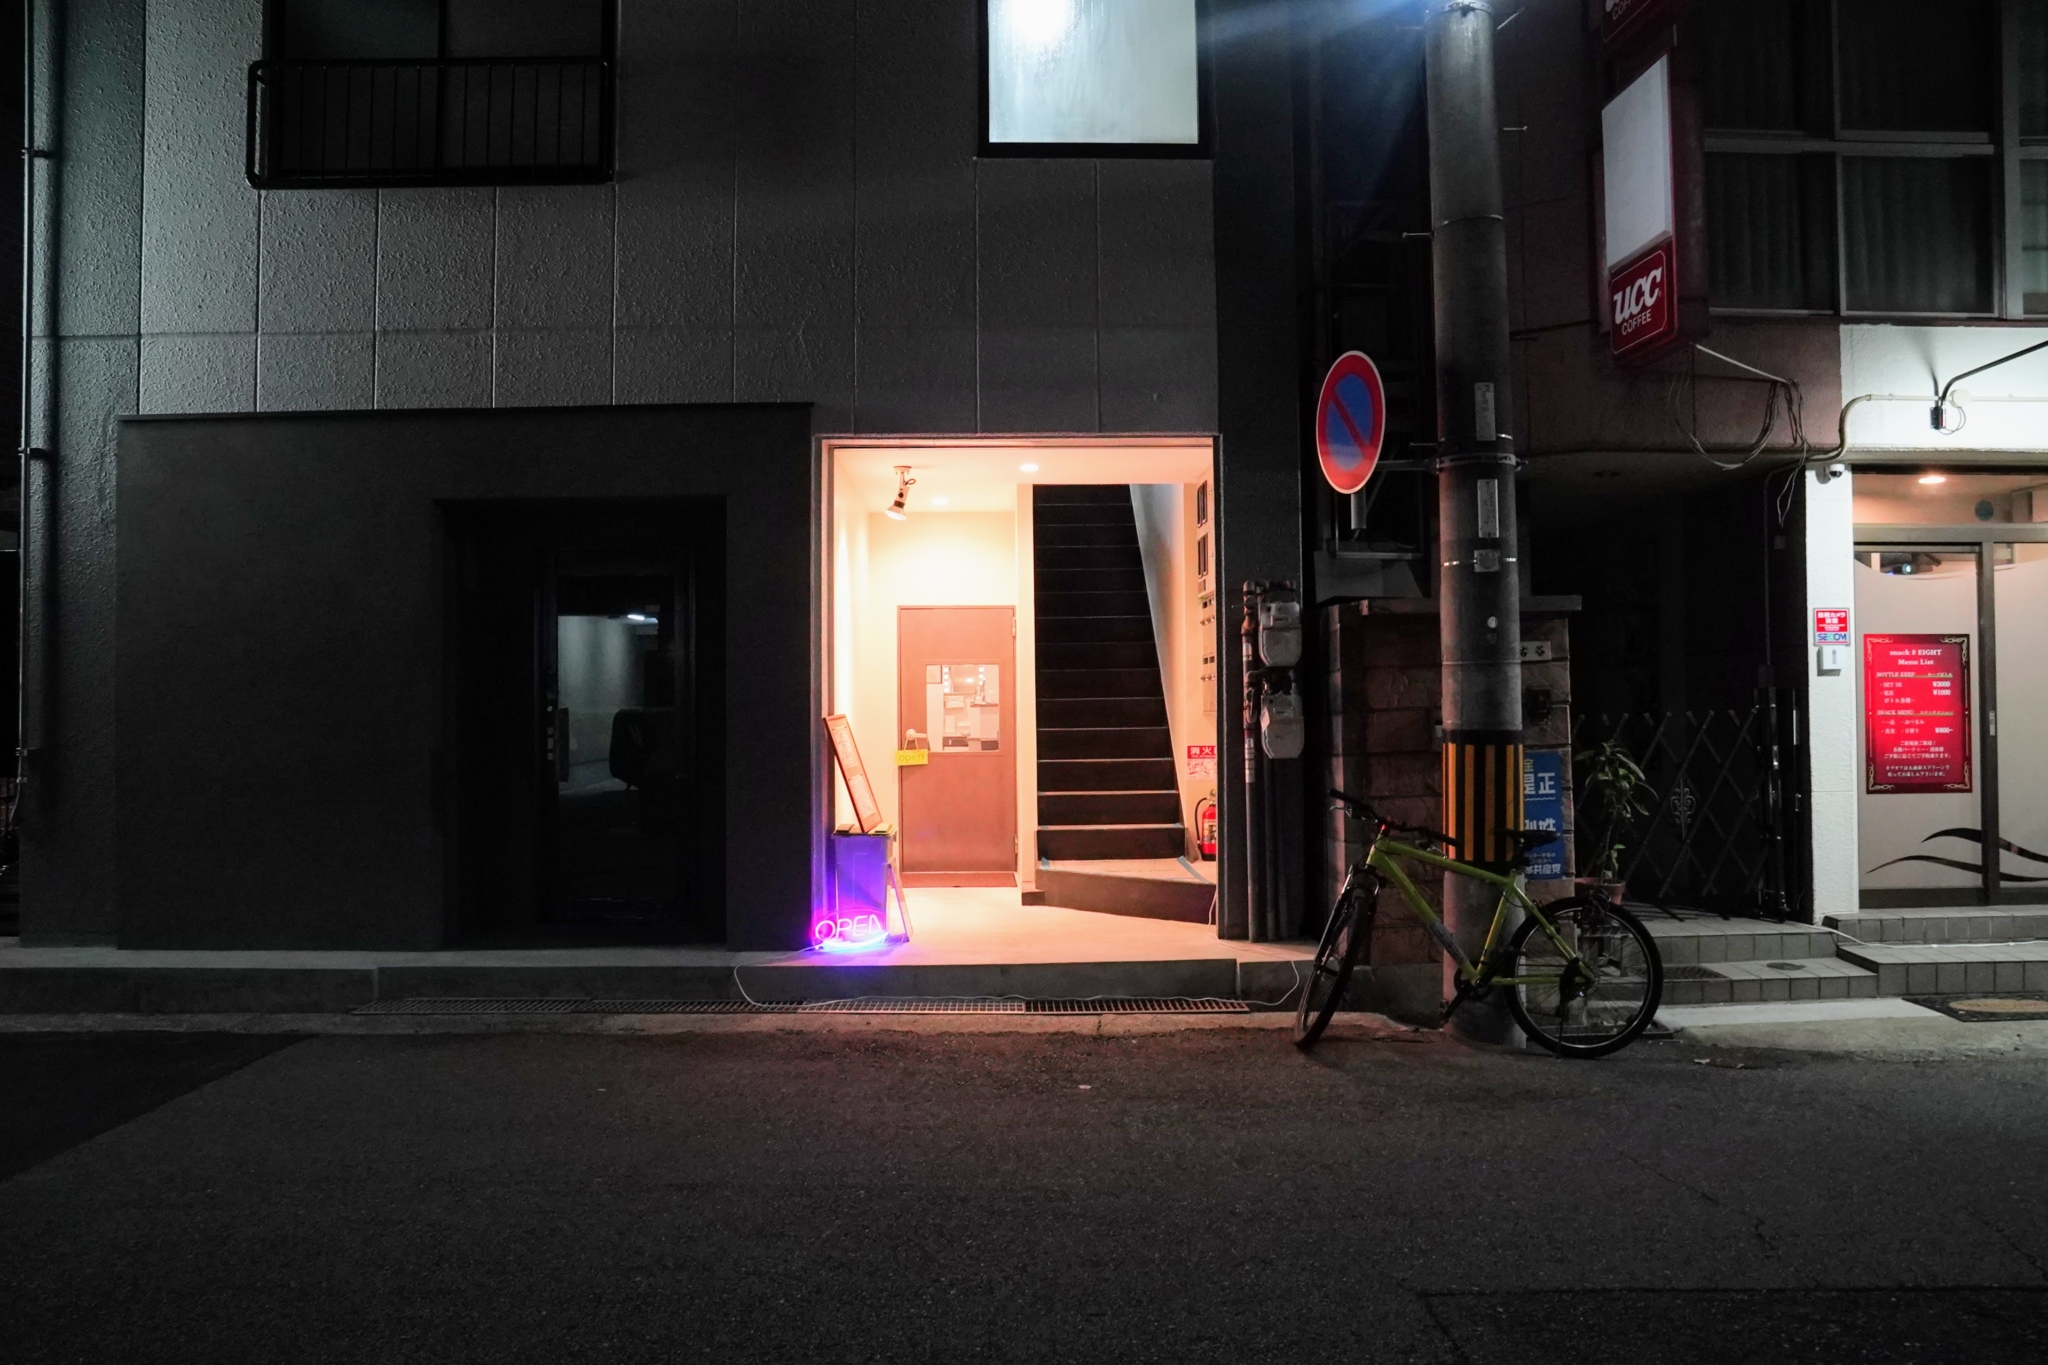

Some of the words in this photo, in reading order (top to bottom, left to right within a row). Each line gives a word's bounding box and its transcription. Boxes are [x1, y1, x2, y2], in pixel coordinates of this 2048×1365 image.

[1613, 266, 1662, 325] UCC
[1621, 308, 1652, 336] COFFEE
[1817, 633, 1847, 641] SECOM
[898, 753, 925, 763] open
[1190, 746, 1216, 755] 消火
[815, 914, 883, 941] OPEN
